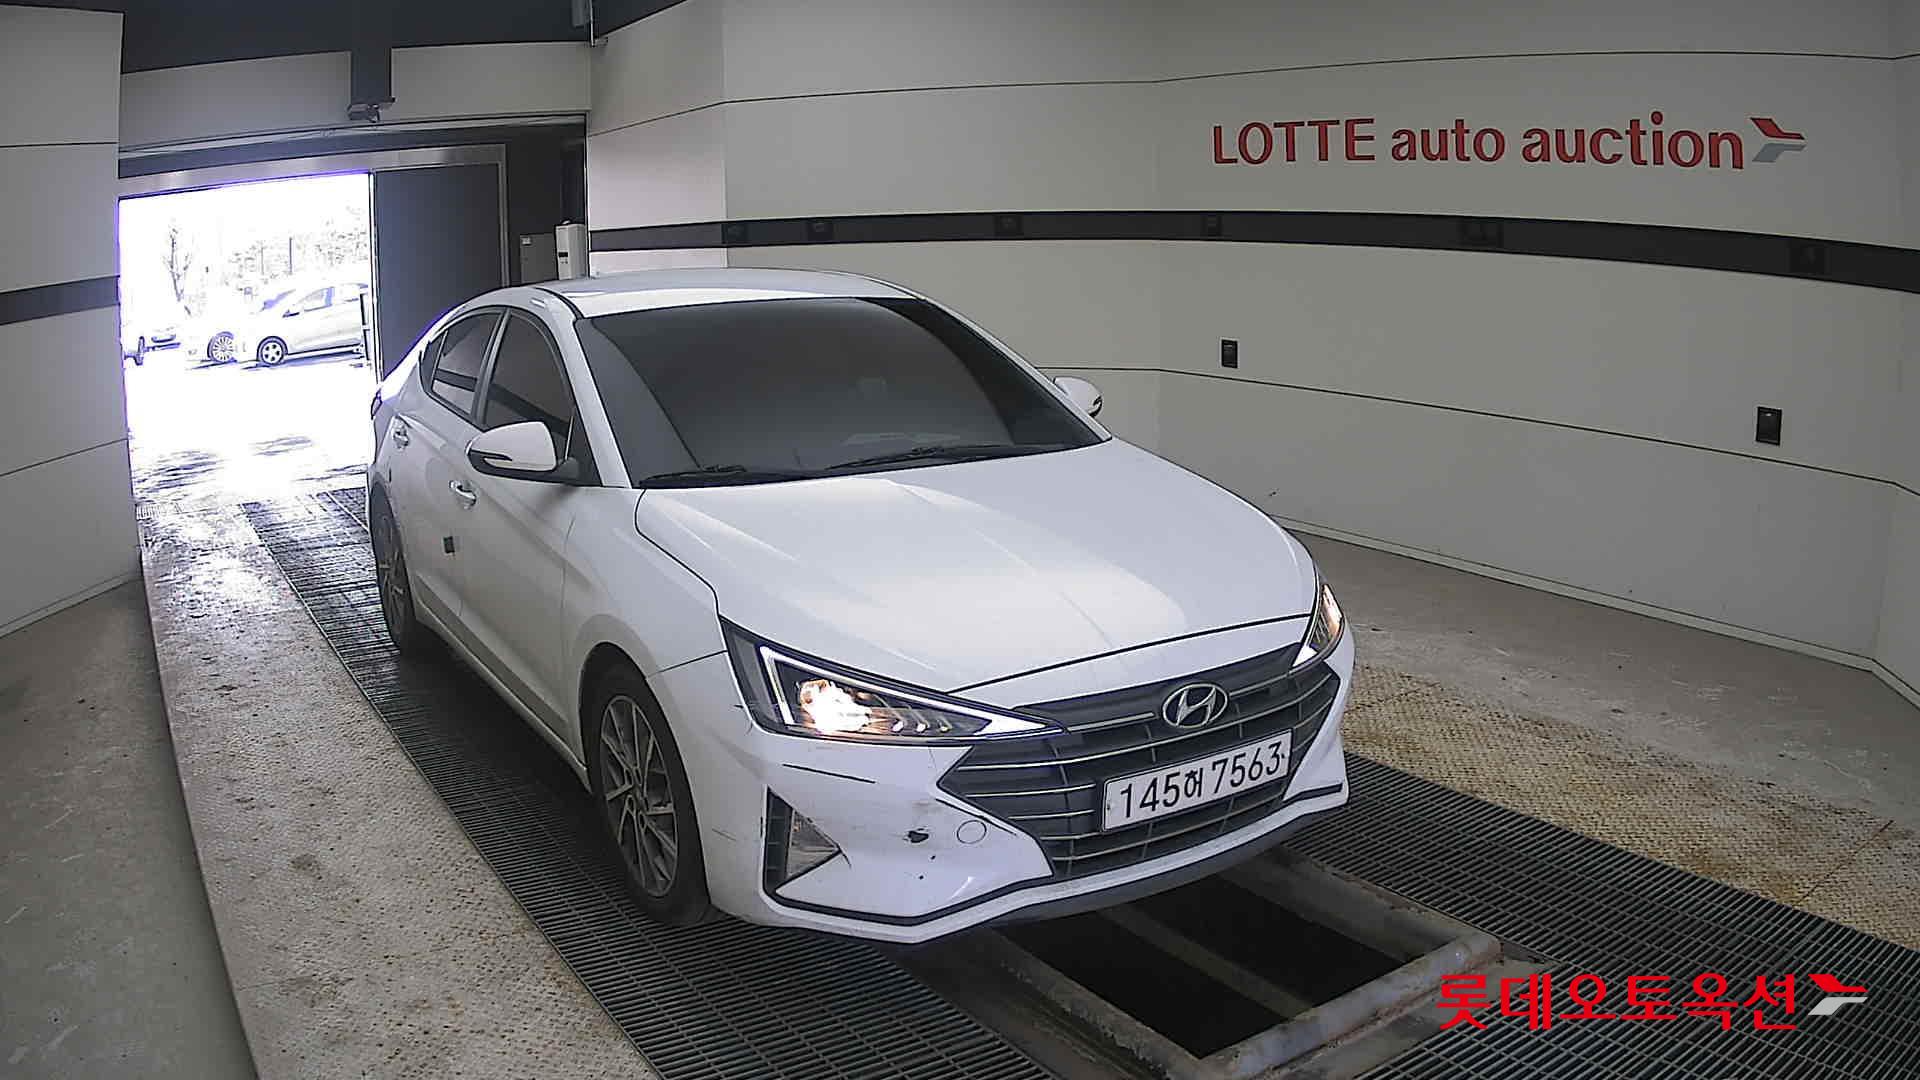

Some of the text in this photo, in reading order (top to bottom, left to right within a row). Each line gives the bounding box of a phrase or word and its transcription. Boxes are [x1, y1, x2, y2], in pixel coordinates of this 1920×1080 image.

[1212, 110, 1744, 170] LOTTE auto auction
[1120, 741, 1283, 819] 145허 7563
